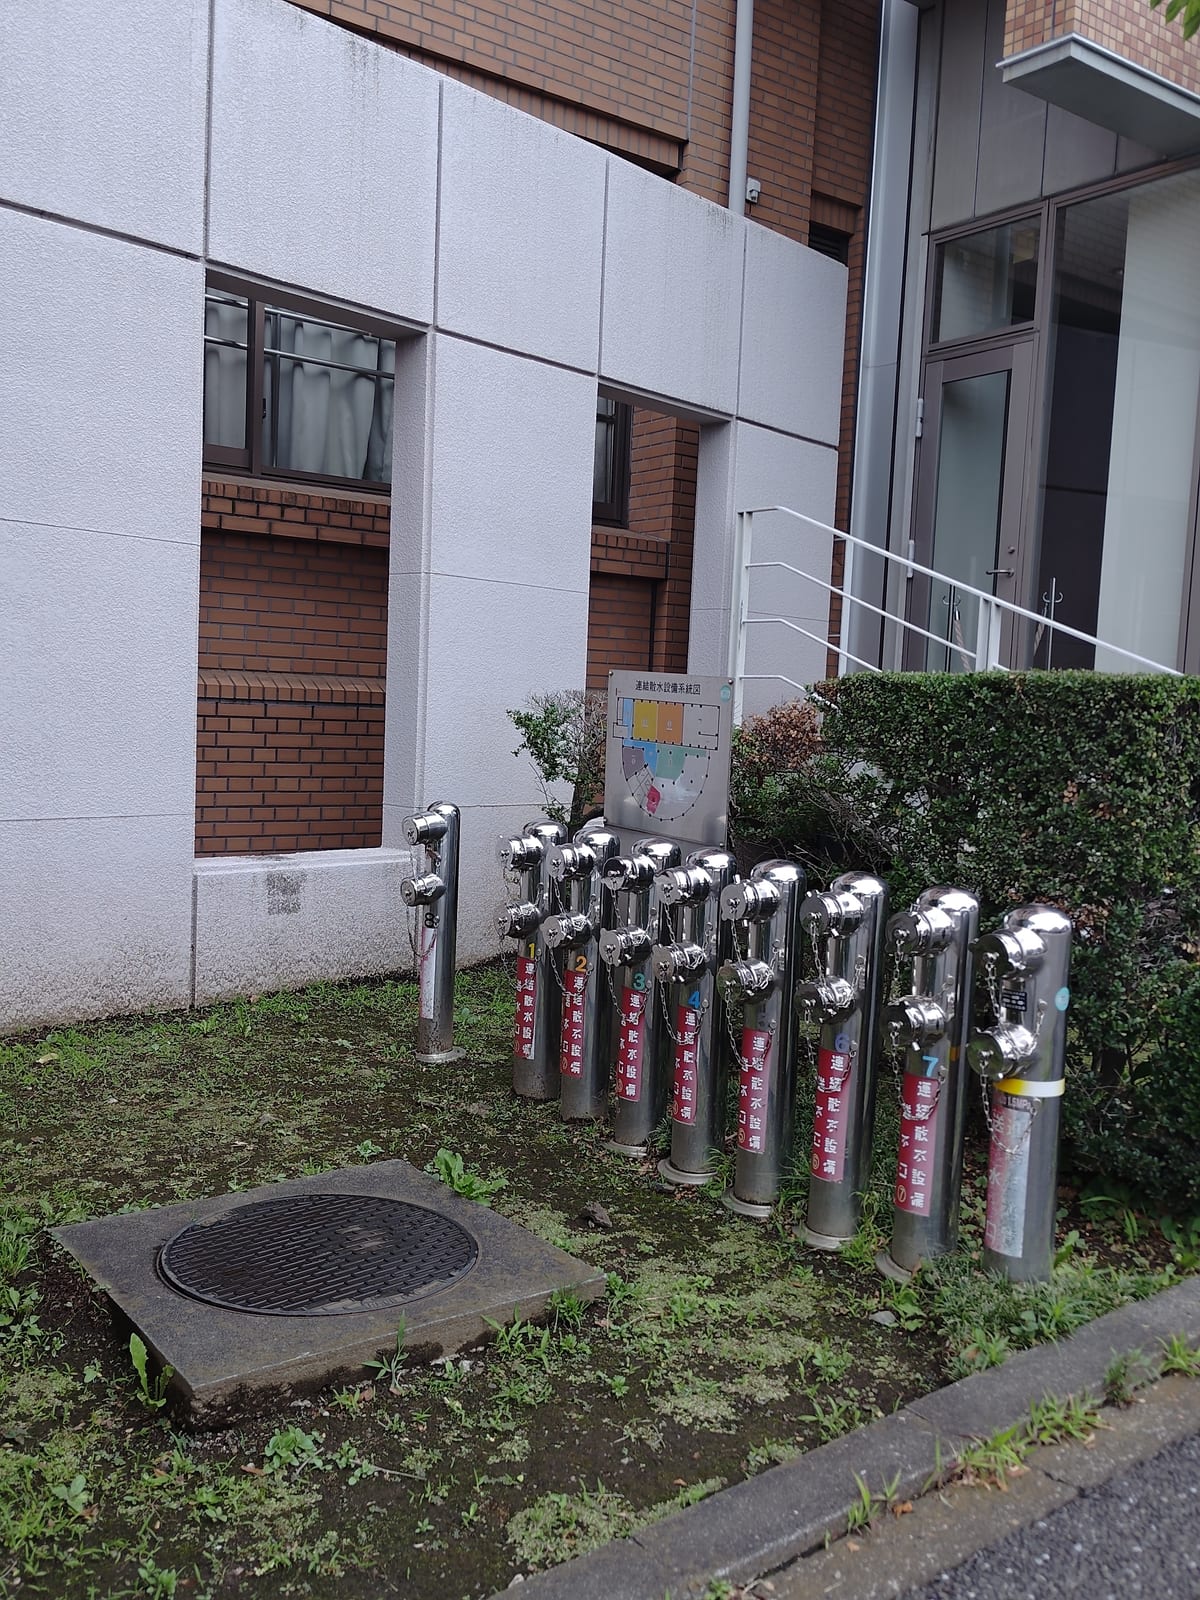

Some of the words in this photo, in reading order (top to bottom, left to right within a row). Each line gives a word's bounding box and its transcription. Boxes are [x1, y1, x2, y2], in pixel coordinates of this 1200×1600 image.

[635, 680, 701, 695] 連結散水設備系統図
[528, 943, 535, 958] 1
[575, 956, 587, 972] 2
[633, 973, 646, 991] 3
[687, 991, 701, 1009] 4
[835, 1033, 849, 1053] 6
[922, 1056, 939, 1077] 7
